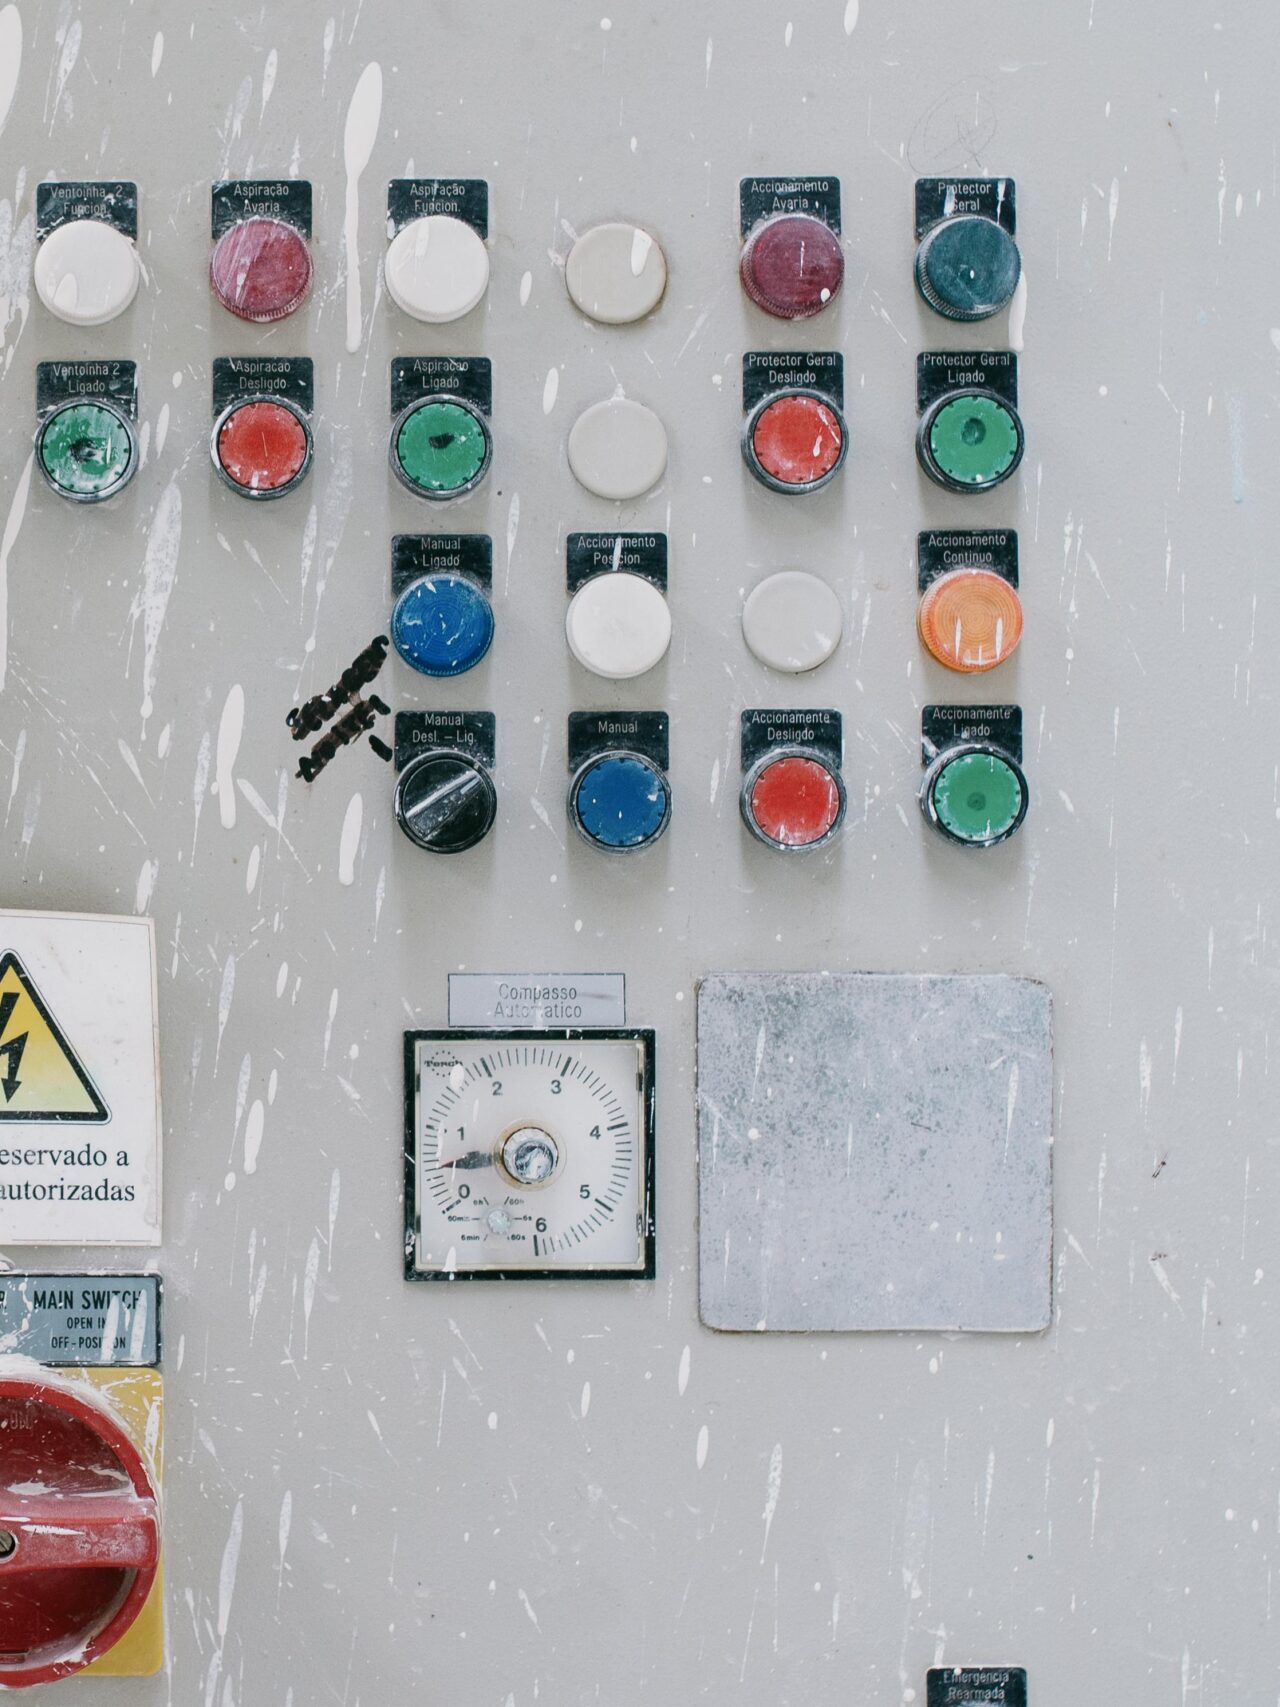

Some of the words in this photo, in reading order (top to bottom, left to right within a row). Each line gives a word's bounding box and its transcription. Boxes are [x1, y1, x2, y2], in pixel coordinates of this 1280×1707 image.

[50, 186, 106, 199] Ventoinha
[116, 185, 124, 198] 2
[233, 183, 289, 197] Aspiração
[409, 183, 465, 197] Aspiração
[751, 181, 829, 193] Accionamento
[938, 183, 991, 195] Protector
[243, 201, 280, 212] Avaria
[772, 197, 808, 209] Avaria
[749, 354, 802, 367] Protector
[806, 353, 836, 366] Geral
[923, 353, 977, 366] Protector
[980, 353, 1010, 365] Geral
[52, 363, 108, 376] Ventoinha
[111, 363, 120, 375] 2
[422, 375, 460, 390] Ligado
[948, 370, 985, 384] Ligado
[68, 380, 105, 395] Ligado
[421, 538, 461, 550] Manual
[928, 534, 1007, 547] Accionamento
[422, 554, 460, 568] Ligado
[943, 551, 993, 563] Continuo
[425, 714, 464, 726] Manual
[598, 721, 638, 733] Manual
[412, 730, 440, 743] Desl.
[457, 730, 477, 745] Lig.
[953, 723, 990, 738] Ligado
[499, 984, 577, 1003] Compasso
[492, 1081, 503, 1096] 2
[551, 1079, 562, 1094] 3
[456, 1126, 464, 1140] 1
[589, 1125, 601, 1139] 4
[116, 1150, 130, 1166] a
[458, 1184, 470, 1199] 0
[579, 1184, 591, 1199] 5
[535, 1217, 547, 1232] 6
[33, 1290, 74, 1309] MAIN
[66, 1317, 93, 1329] OPEN
[948, 1687, 1005, 1700] Rearmada
